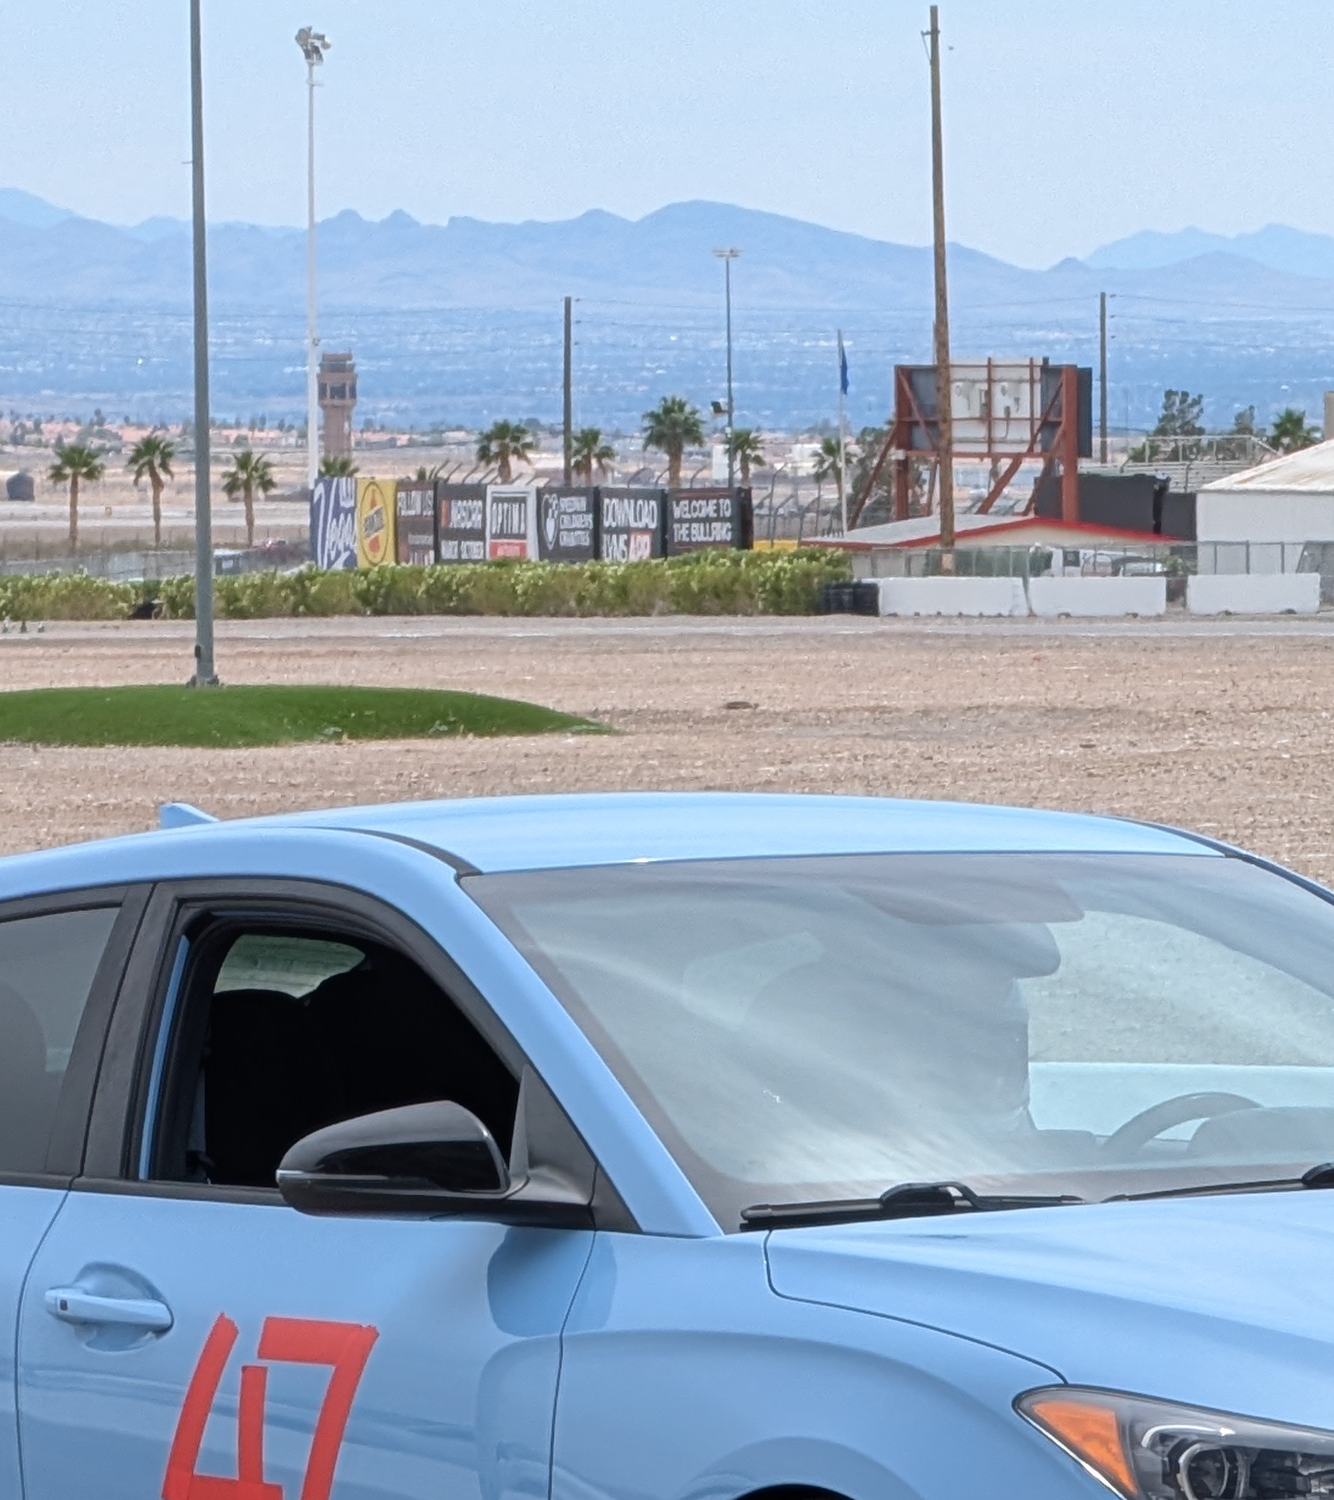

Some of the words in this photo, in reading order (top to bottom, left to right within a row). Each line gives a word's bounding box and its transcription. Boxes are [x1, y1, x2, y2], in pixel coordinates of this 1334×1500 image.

[491, 502, 526, 534] OPTIMA
[603, 498, 658, 529] DOWNLOAD
[673, 499, 717, 519] WELCOME
[718, 498, 732, 518] TO
[673, 522, 689, 543] THE
[690, 521, 732, 542] BULLRING
